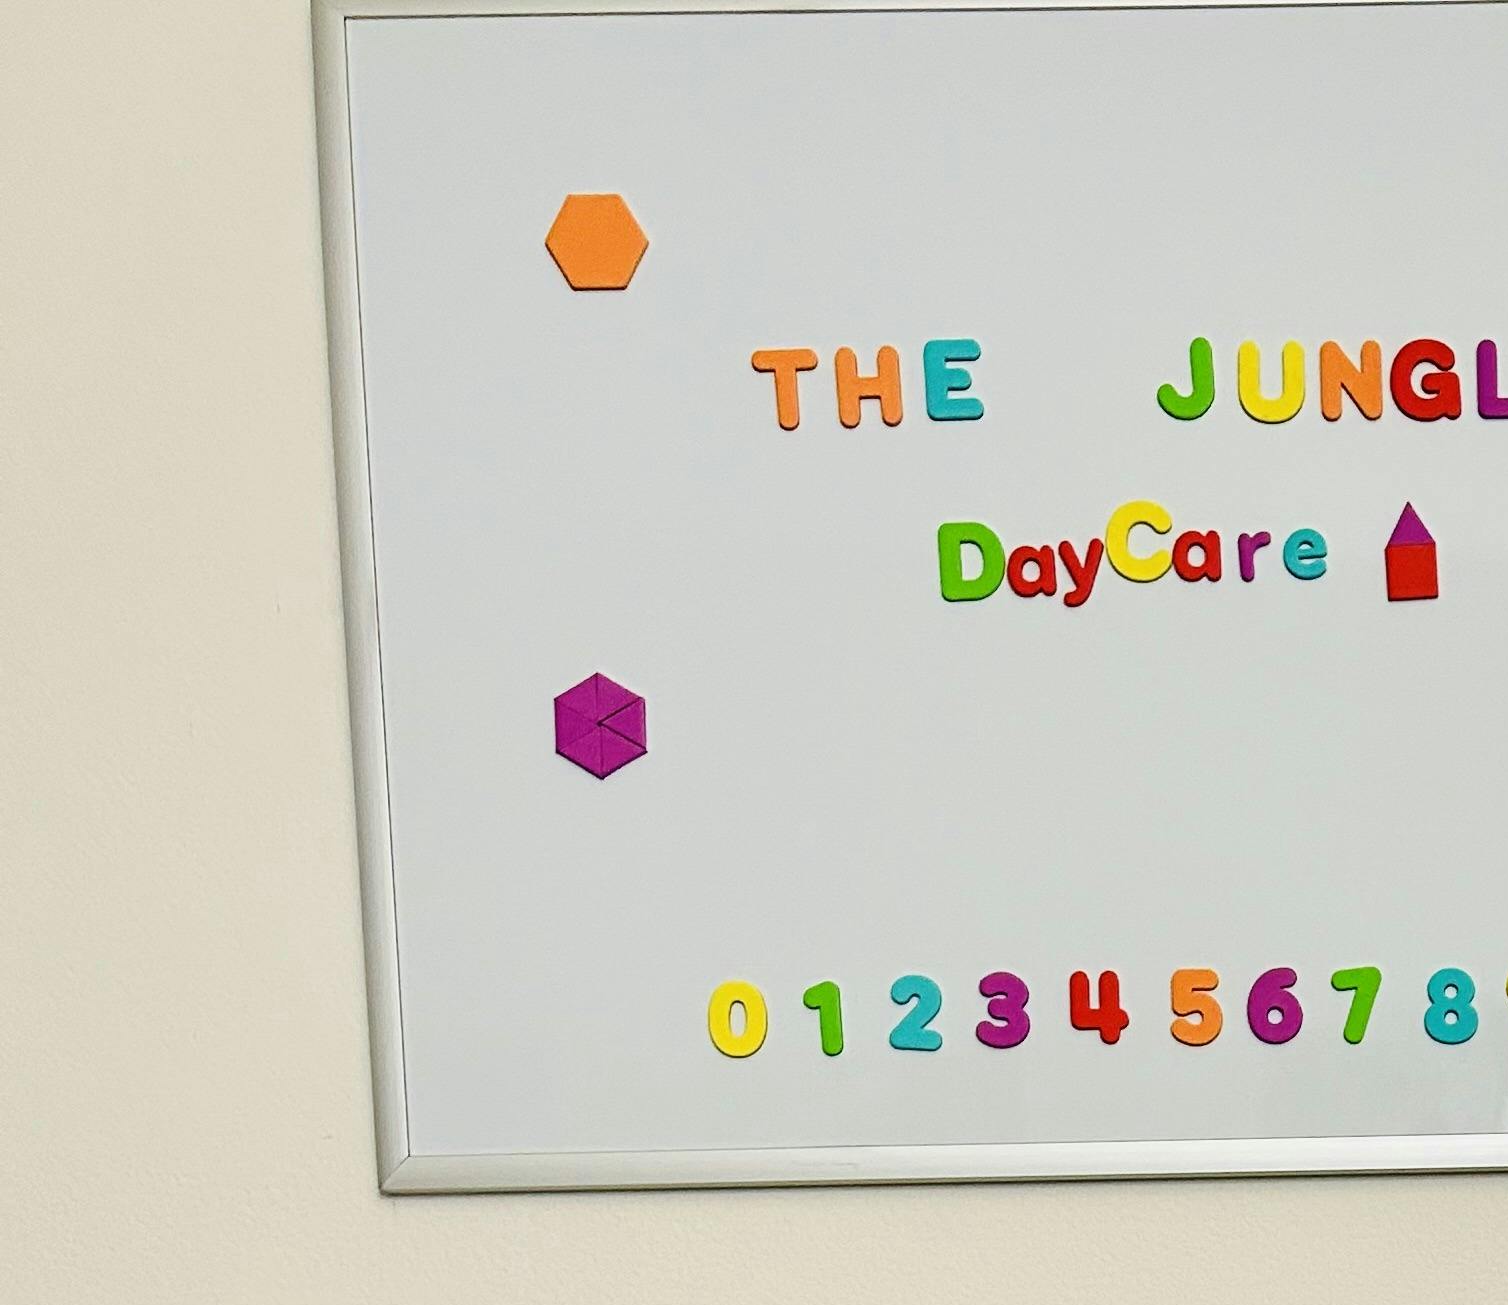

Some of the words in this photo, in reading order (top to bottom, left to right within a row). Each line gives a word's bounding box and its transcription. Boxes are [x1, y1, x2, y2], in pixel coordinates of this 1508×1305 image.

[751, 338, 985, 431] THE
[707, 980, 768, 1058] 0
[803, 980, 844, 1056] 1
[888, 974, 943, 1052] 2
[975, 971, 1030, 1049] 3
[1069, 969, 1130, 1045] 4
[1169, 967, 1223, 1047] 5
[1246, 967, 1304, 1044] 6
[1330, 966, 1383, 1044] 7
[1423, 967, 1480, 1045] 8
